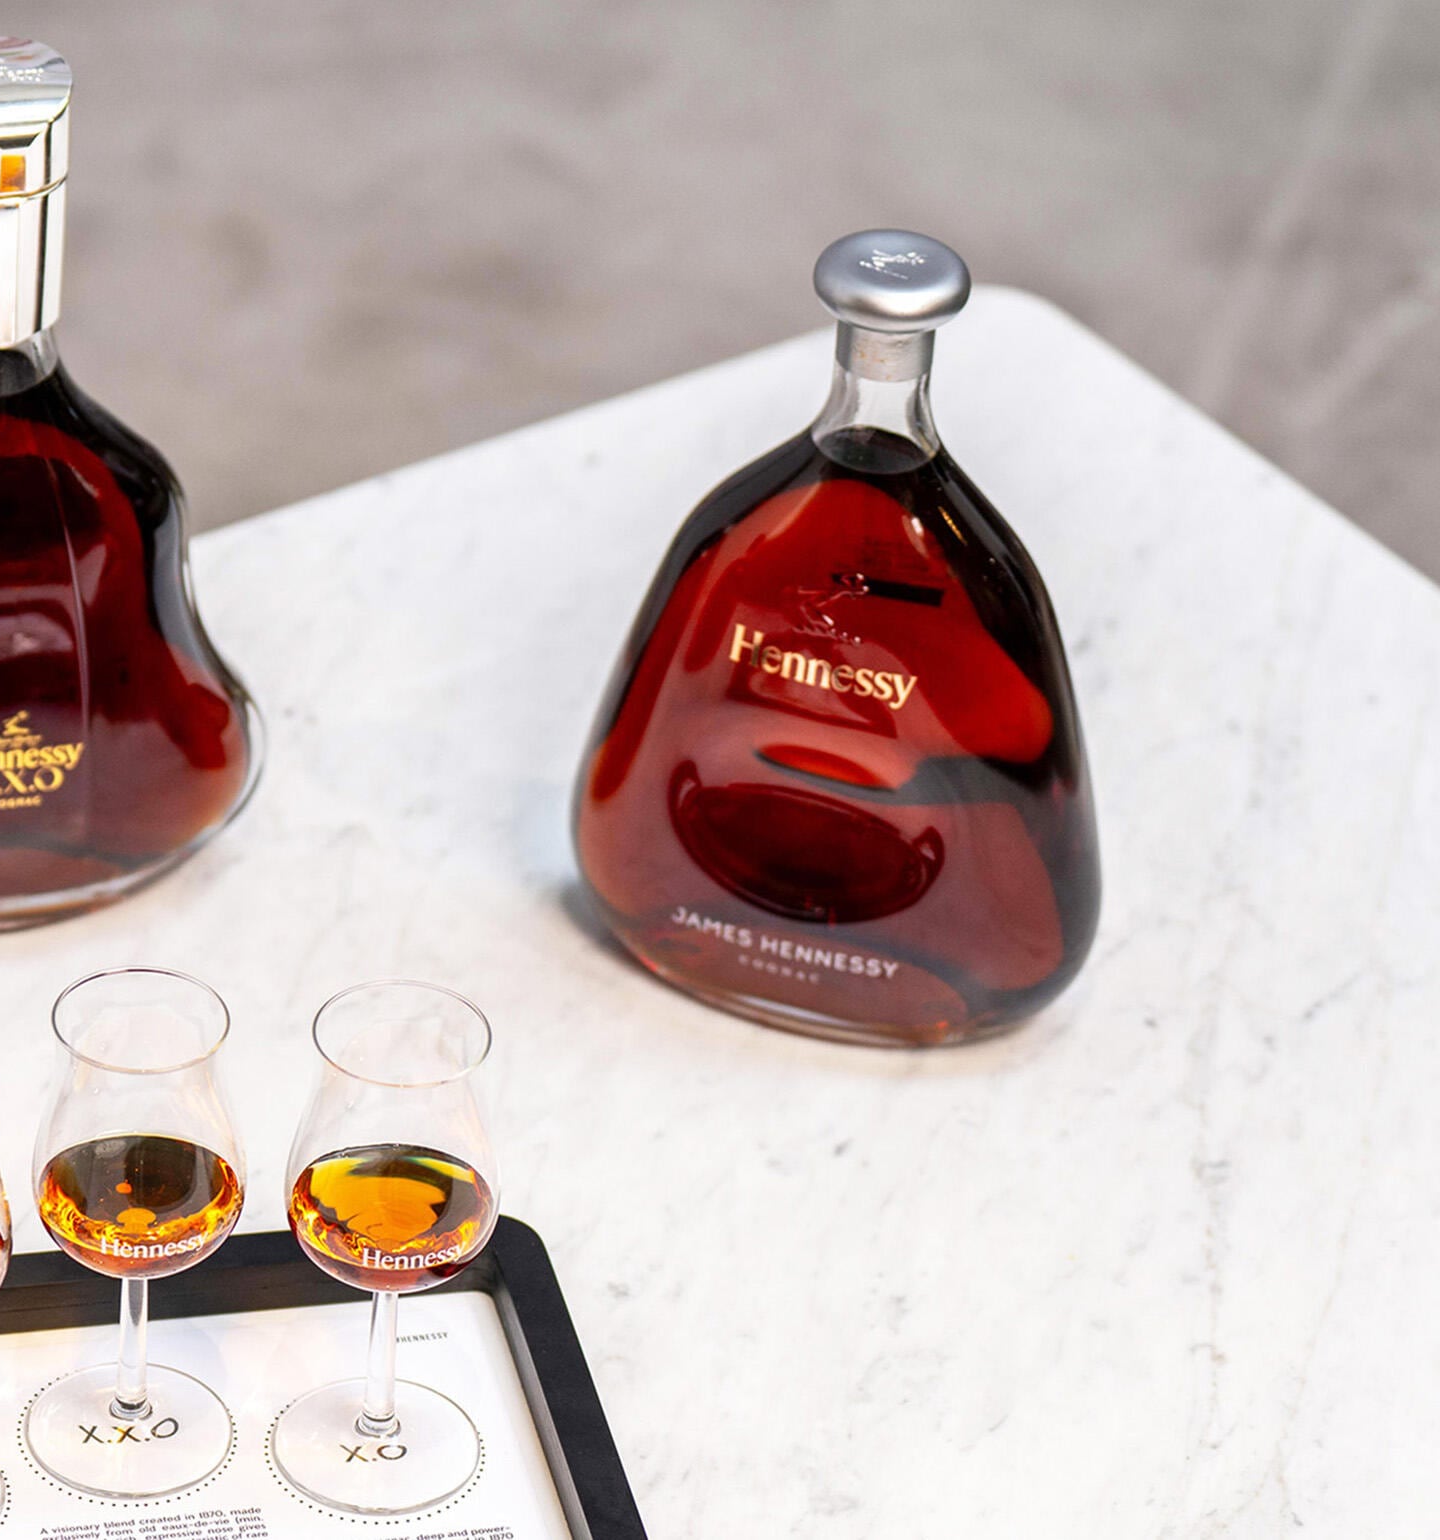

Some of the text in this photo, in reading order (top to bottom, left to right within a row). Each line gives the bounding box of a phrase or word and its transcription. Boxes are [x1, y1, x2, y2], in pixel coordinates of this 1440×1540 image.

[728, 623, 918, 710] Hennessy
[671, 906, 900, 980] JAMES HENNESSY
[101, 1231, 210, 1259] Hennessy
[362, 1241, 466, 1270] Hennessy
[78, 1417, 180, 1444] X.X.O
[339, 1444, 408, 1463] X.O
[40, 1527, 49, 1535] A
[51, 1524, 100, 1534] visionary
[103, 1519, 136, 1529] blend
[139, 1514, 181, 1525] created
[184, 1513, 196, 1521] in
[230, 1507, 261, 1515] made
[106, 1528, 133, 1537] from
[139, 1525, 157, 1534] old
[162, 1519, 230, 1531] eaux-de-vie
[145, 1528, 202, 1540] expressive
[208, 1525, 234, 1534] nose
[239, 1522, 267, 1533] gives
[447, 1529, 468, 1538] and
[471, 1526, 511, 1537] power-
[246, 1531, 268, 1539] rare
